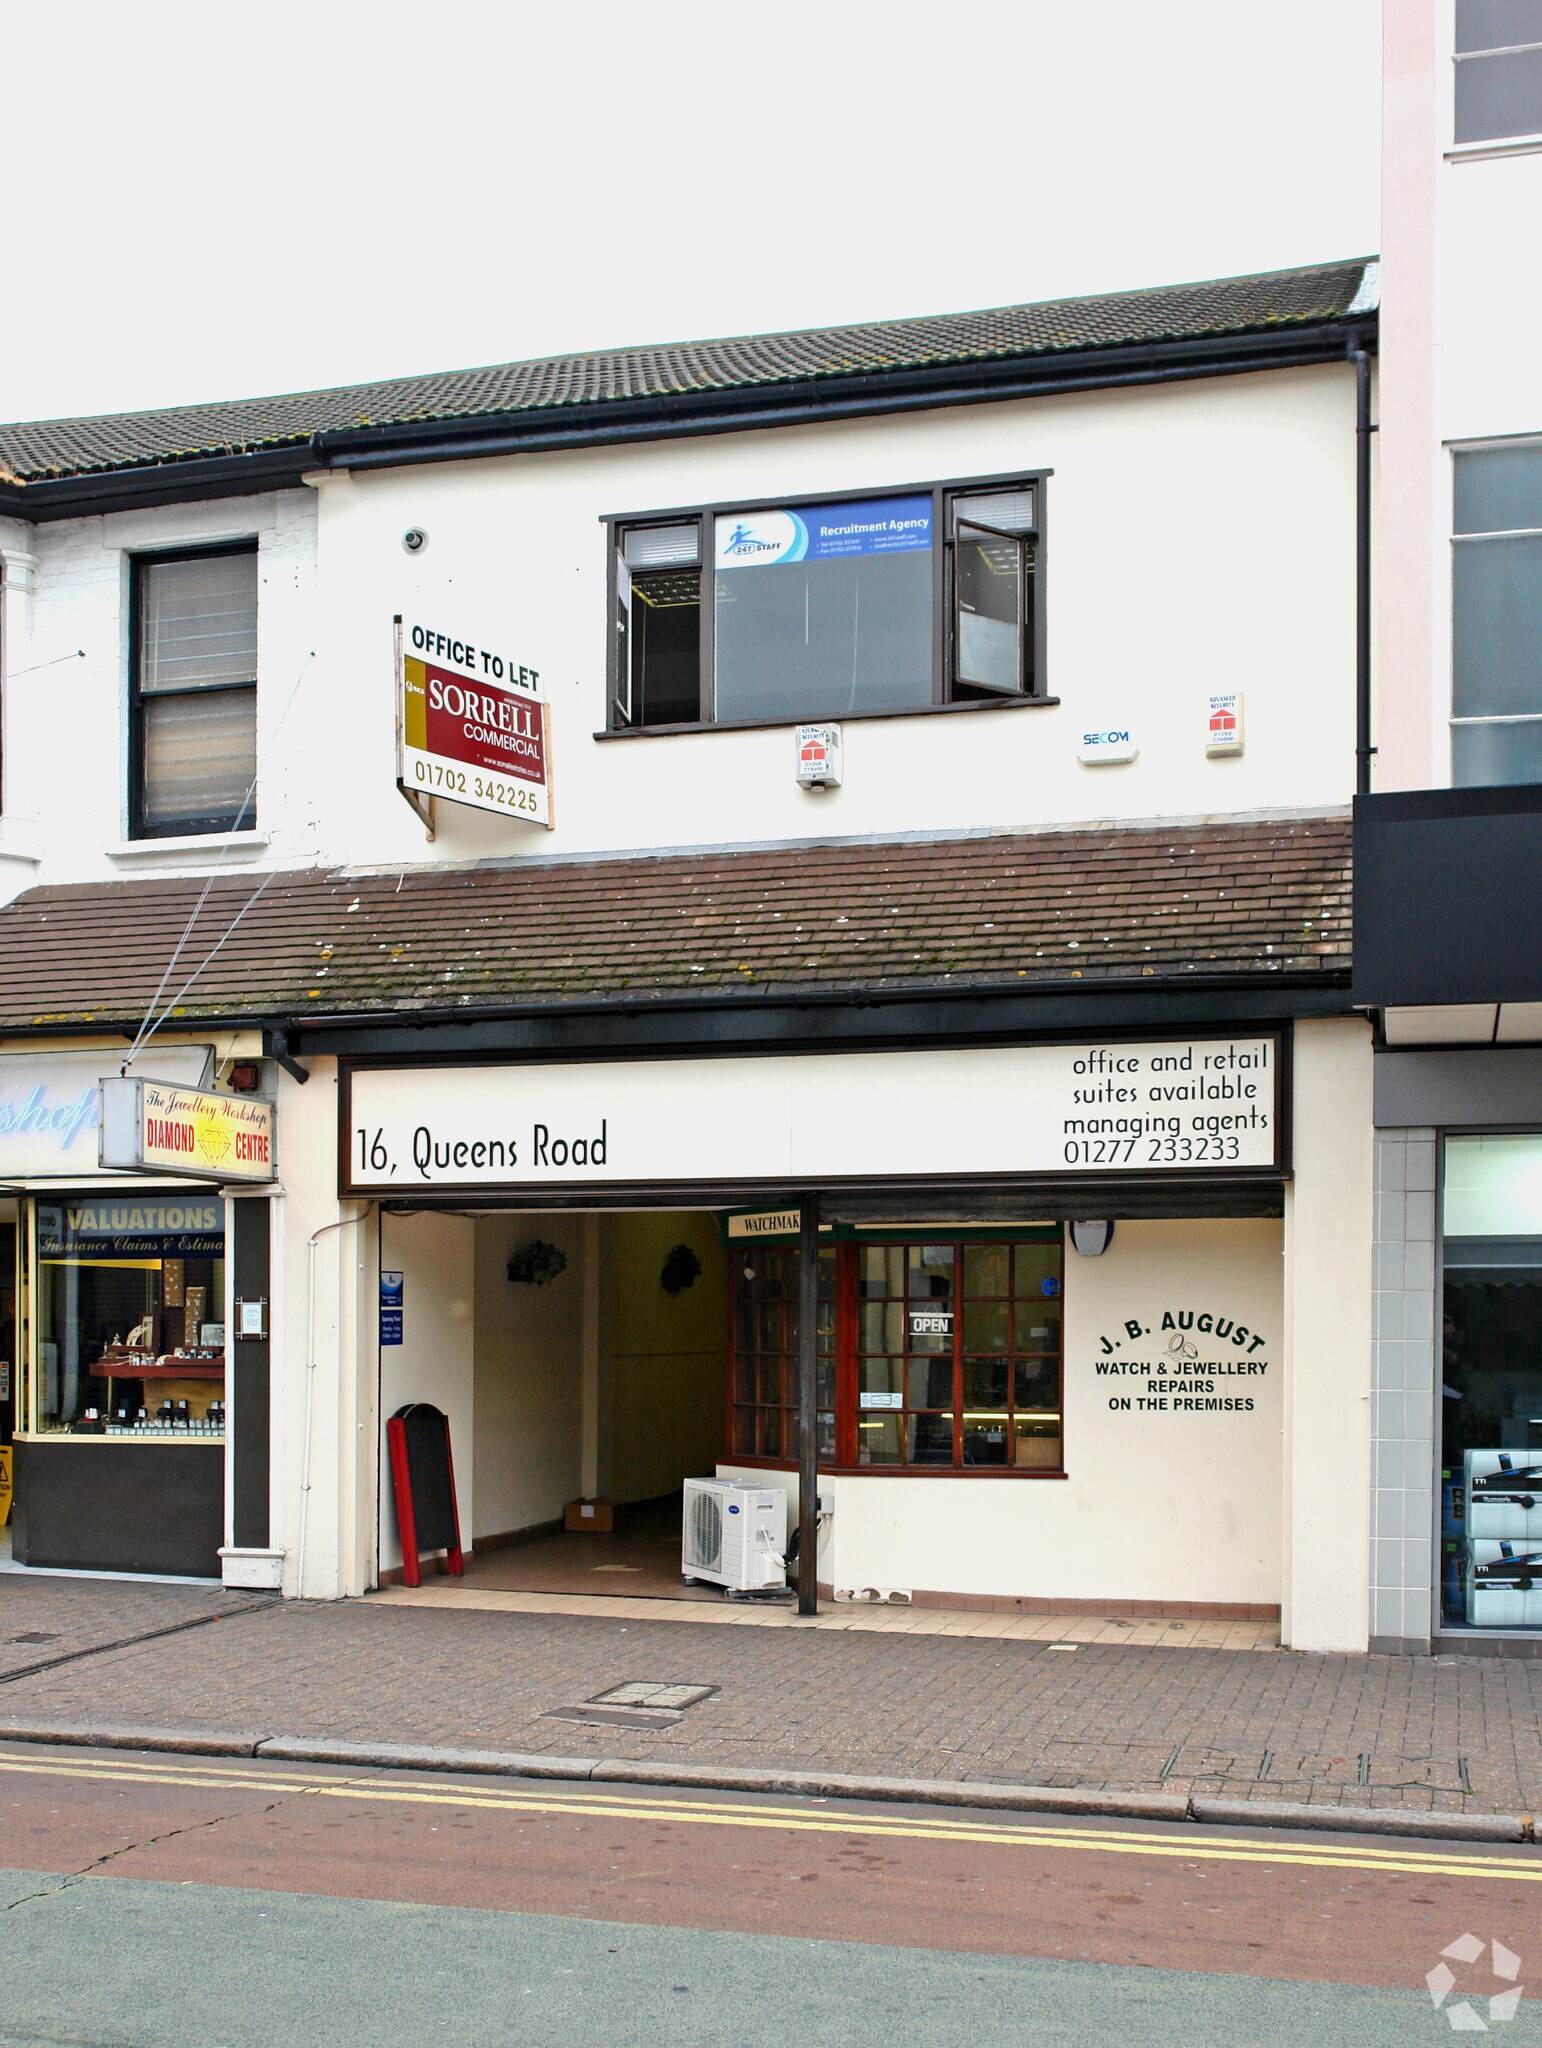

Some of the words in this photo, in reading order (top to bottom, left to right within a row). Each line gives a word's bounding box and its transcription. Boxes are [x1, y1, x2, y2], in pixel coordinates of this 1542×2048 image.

[820, 523, 888, 537] Recruitment
[889, 518, 930, 532] Agency
[736, 545, 753, 554] 247
[756, 542, 782, 552] STAFF
[412, 625, 476, 669] OFFICE
[480, 650, 504, 679] TO
[509, 662, 540, 692] LET
[429, 678, 541, 741] SORRELL
[463, 722, 541, 760] COMMERCIAL
[1083, 731, 1130, 745] SECOM
[415, 760, 467, 794] 01702
[474, 777, 538, 813] 342225
[1073, 1049, 1140, 1075] office
[1150, 1046, 1193, 1072] and
[1203, 1043, 1267, 1070] retail
[1073, 1078, 1138, 1104] suites
[1149, 1074, 1258, 1102] available
[146, 1089, 166, 1108] The
[165, 1092, 217, 1122] Jewellery
[219, 1100, 268, 1130] Workshop
[1064, 1111, 1181, 1139] managing
[1191, 1104, 1268, 1137] agents
[147, 1118, 195, 1153] DIAMOND
[235, 1131, 269, 1163] CENTRE
[357, 1127, 398, 1177] 16,
[413, 1126, 518, 1180] Queens
[533, 1118, 607, 1167] Road
[1064, 1139, 1137, 1164] 01277
[1148, 1136, 1240, 1162] 233233
[66, 1206, 216, 1231] VALUATIONS
[41, 1236, 108, 1253] Insurance
[112, 1235, 158, 1252] Claims
[913, 1317, 948, 1333] OPEN
[1100, 1335, 1122, 1355] J.
[1124, 1319, 1151, 1340] B.
[1161, 1310, 1266, 1354] AUGUST
[1095, 1362, 1151, 1375] WATCH
[1156, 1362, 1168, 1375] &
[1173, 1362, 1269, 1375] JEWELLERY
[1147, 1380, 1215, 1393] REPAIRS
[1108, 1397, 1131, 1411] ON
[1136, 1397, 1168, 1411] THE
[1173, 1397, 1255, 1411] PREMISES
